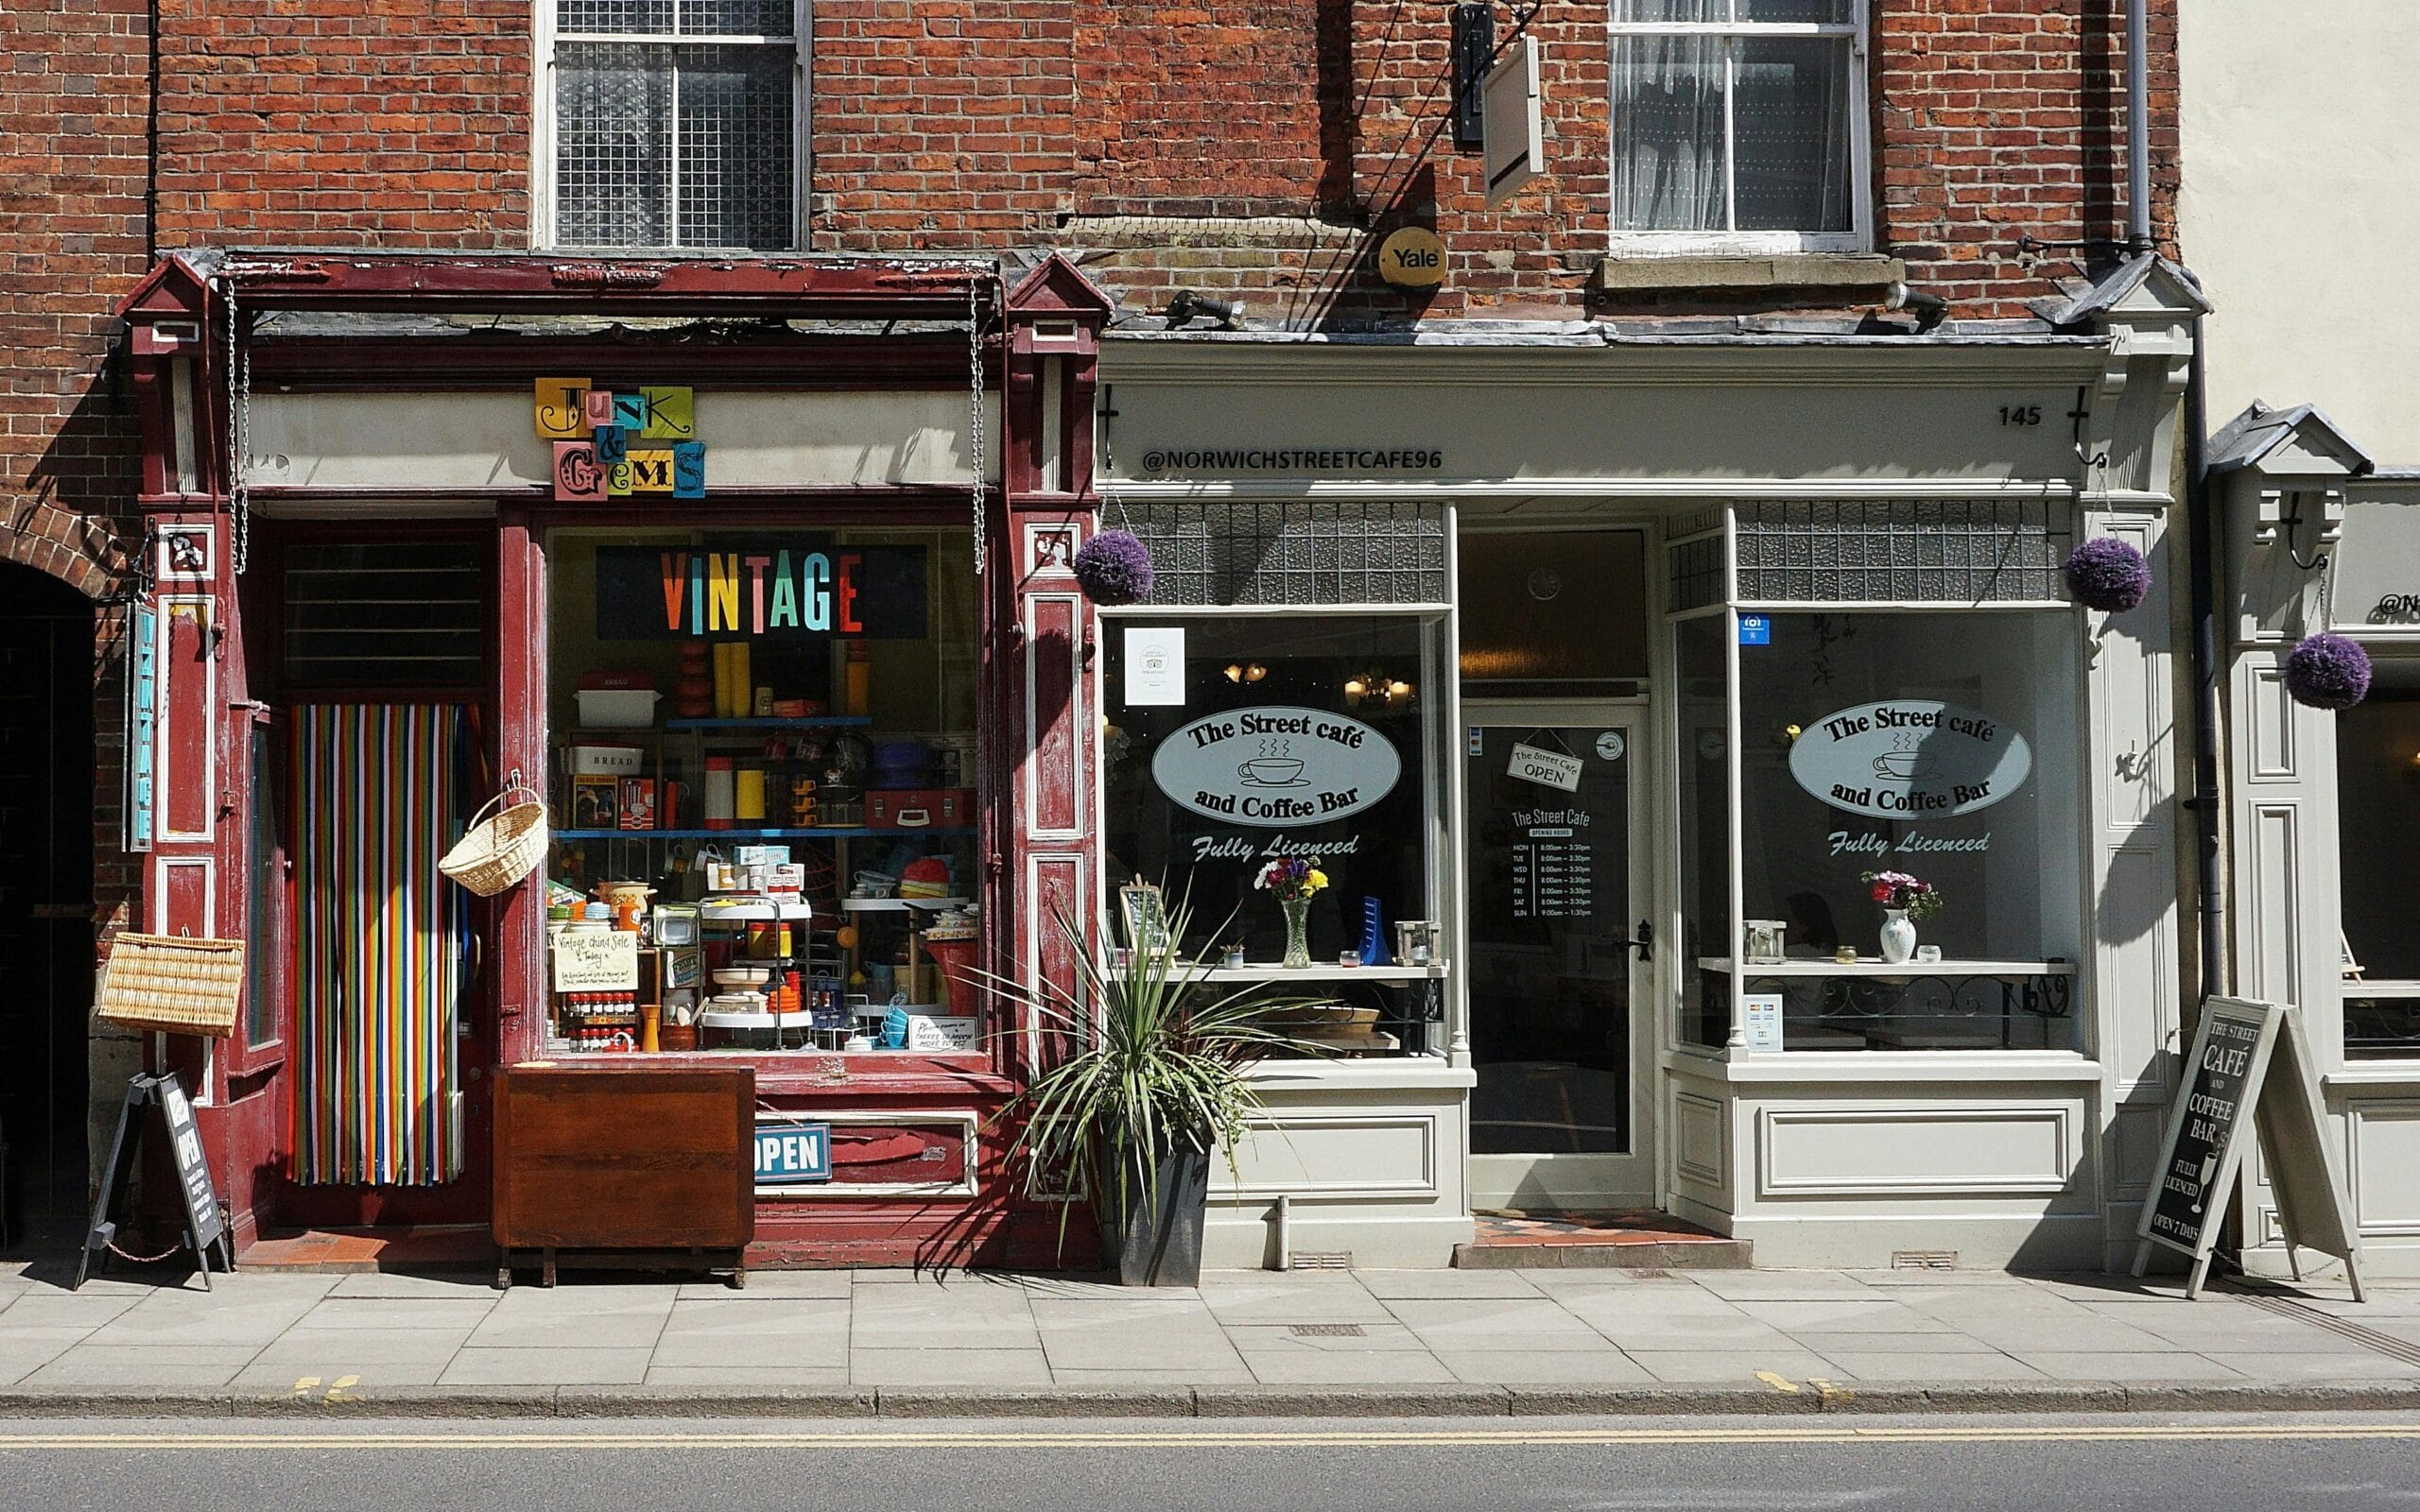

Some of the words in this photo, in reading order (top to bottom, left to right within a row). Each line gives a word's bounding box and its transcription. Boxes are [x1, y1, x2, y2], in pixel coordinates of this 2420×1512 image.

[1393, 248, 1439, 267] Yale
[1999, 406, 2042, 425] 145
[599, 425, 622, 458] &
[1143, 451, 1443, 472] @NORWICHSTREETCAFE96
[662, 550, 862, 634] VINTAGE
[2379, 593, 2420, 614] @N
[1187, 721, 1235, 749] The
[1240, 713, 1310, 735] Street
[1317, 722, 1366, 749] café
[1824, 716, 1869, 742] The
[1876, 707, 1943, 730] Street
[1949, 715, 1996, 742] café
[594, 756, 632, 765] BREAD
[1515, 751, 1531, 761] The
[1534, 752, 1559, 765] Street
[1524, 764, 1564, 783] OPEN
[1195, 790, 1236, 815] and
[1242, 797, 1315, 818] Coffee
[1318, 787, 1358, 813] Bar
[1831, 783, 1870, 806] and
[1876, 790, 1947, 812] Coffee
[1952, 781, 1991, 804] Bar
[1512, 811, 1531, 827] The
[1533, 809, 1564, 824] Street
[1566, 809, 1590, 827] Cafe
[1192, 835, 1254, 863] Fully
[1261, 834, 1359, 856] Licenced
[1827, 831, 1889, 857] Fully
[1894, 831, 1991, 852] Licenced
[559, 936, 585, 954] Vintage
[612, 935, 630, 950] Sale
[2210, 1022, 2228, 1038] THE
[2229, 1023, 2259, 1042] STREET
[2204, 1044, 2249, 1077] CAFÉ
[2211, 1078, 2225, 1090] AND
[2189, 1092, 2235, 1122] COFFEE
[2190, 1118, 2216, 1143] BAR
[2175, 1159, 2199, 1177] FULLY
[2165, 1175, 2199, 1197] LICENCED
[2153, 1212, 2175, 1230] OPEN
[2181, 1221, 2199, 1241] DAYS
